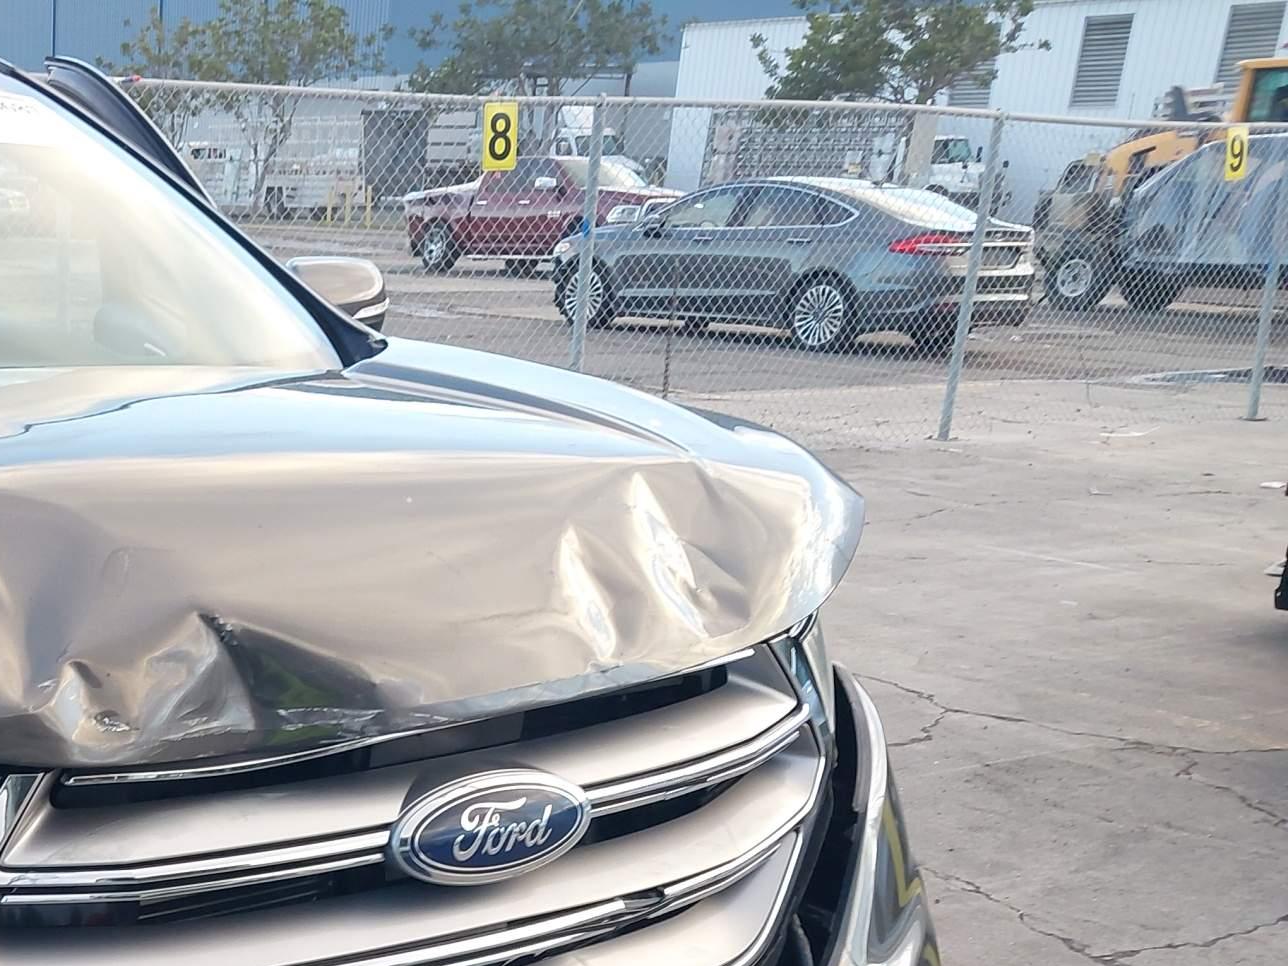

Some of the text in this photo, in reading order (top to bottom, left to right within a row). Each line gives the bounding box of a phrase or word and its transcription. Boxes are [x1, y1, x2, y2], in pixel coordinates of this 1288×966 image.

[488, 112, 512, 161] 8
[1229, 134, 1245, 173] 9
[452, 796, 554, 862] Ford
